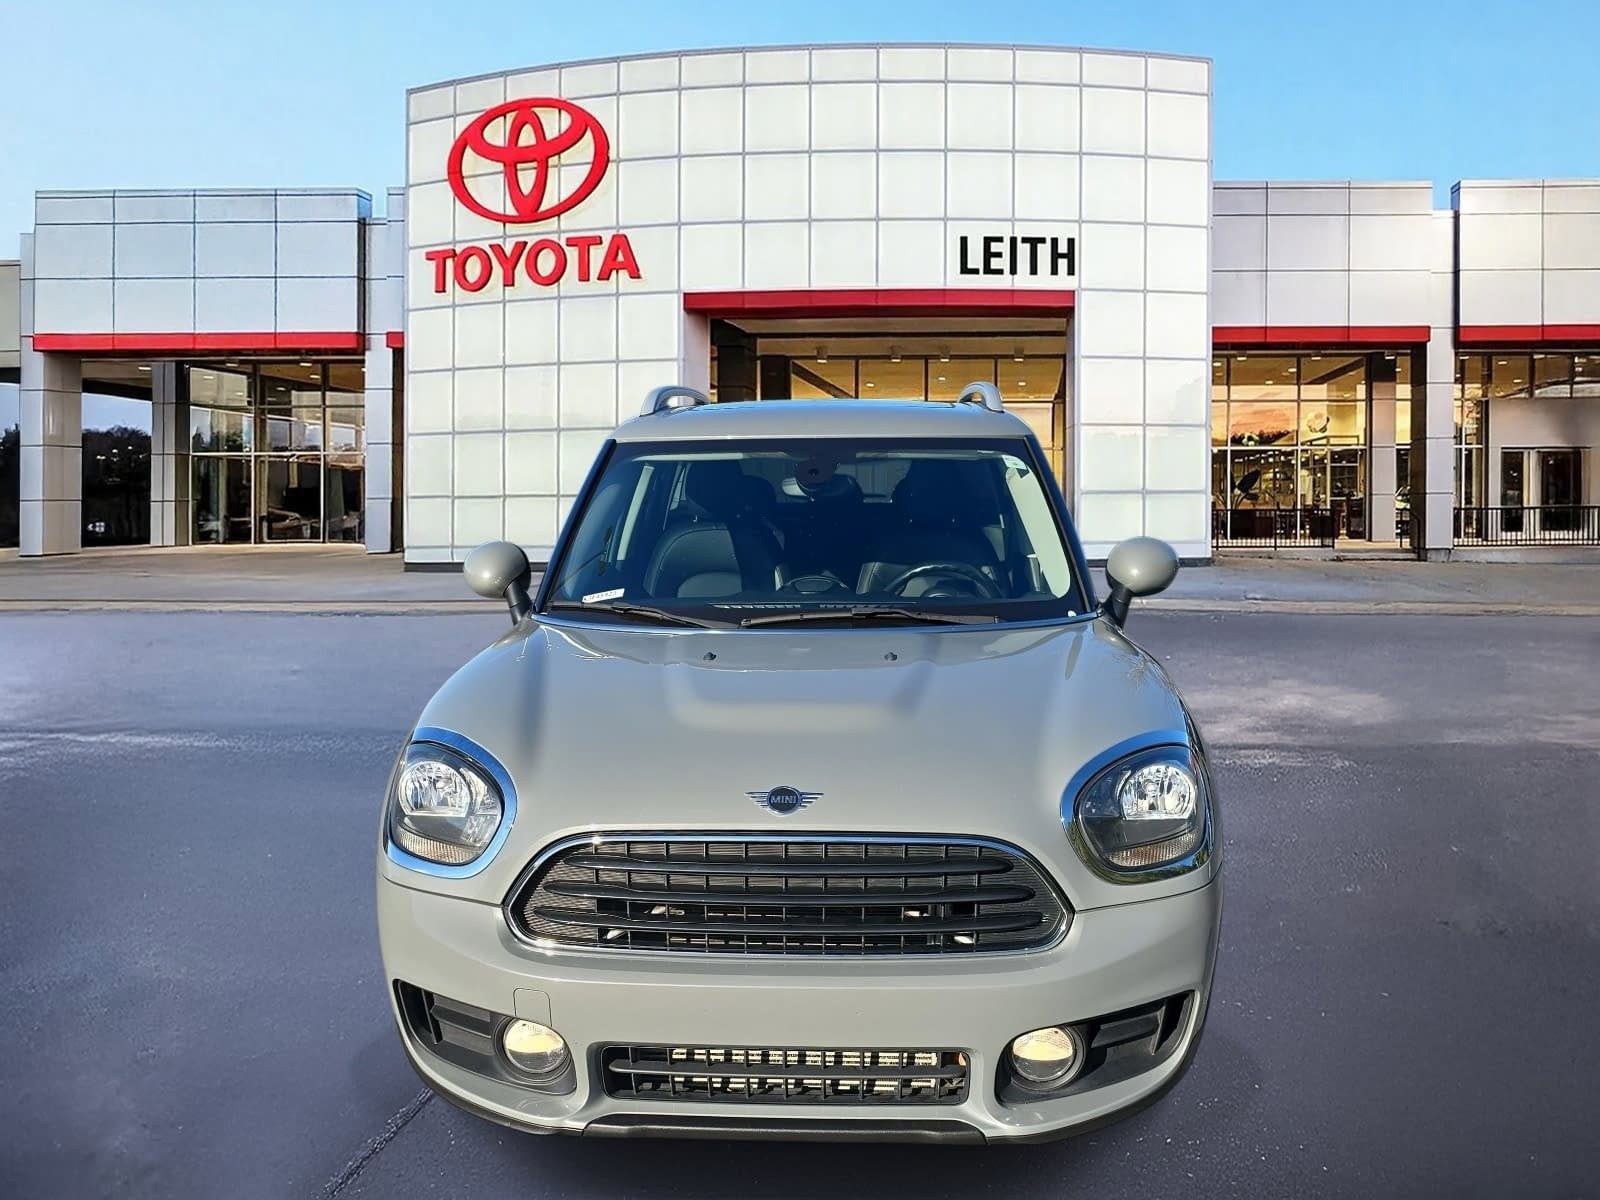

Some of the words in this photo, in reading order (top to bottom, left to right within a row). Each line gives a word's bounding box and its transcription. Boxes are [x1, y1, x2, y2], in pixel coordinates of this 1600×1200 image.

[426, 233, 641, 293] TOYOTA
[960, 236, 1075, 275] LEITH
[770, 795, 797, 804] MINI
